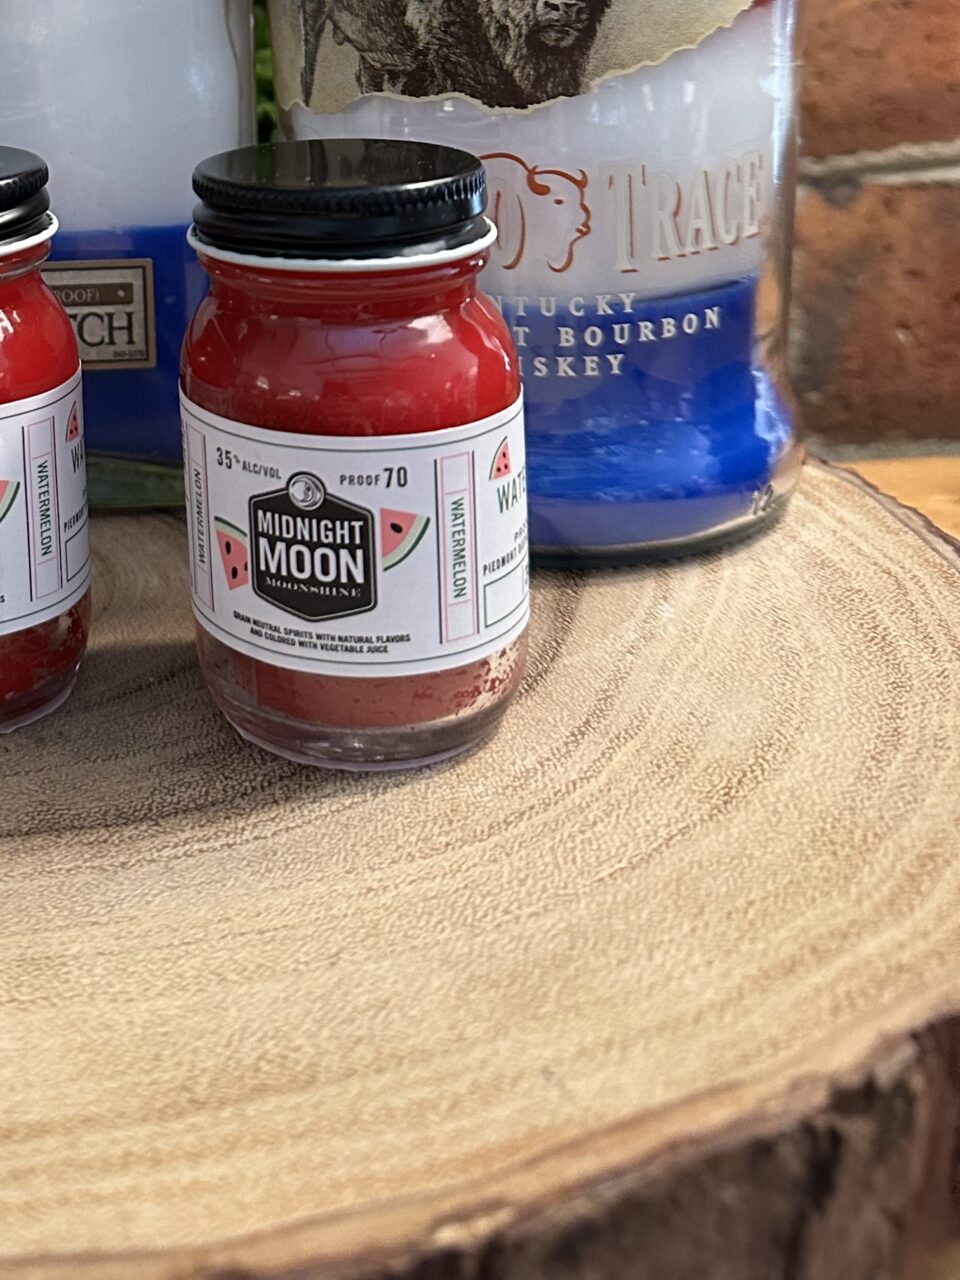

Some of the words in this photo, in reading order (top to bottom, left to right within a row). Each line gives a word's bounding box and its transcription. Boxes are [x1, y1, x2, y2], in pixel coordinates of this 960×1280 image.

[598, 151, 764, 273] TRACE
[558, 306, 721, 348] BOURBON
[242, 460, 282, 480] ALC/VOL
[340, 474, 381, 487] PROOF
[383, 467, 408, 488] 70
[37, 460, 53, 557] WATERMELON
[194, 469, 206, 564] WATERMELON
[257, 508, 364, 545] MIDNIGHT
[259, 536, 365, 584] MOON
[450, 496, 468, 599] WATERMELON
[265, 576, 361, 598] MOONSHINE
[233, 610, 251, 624] GRAIN
[252, 619, 281, 634] NEUTRAL
[283, 628, 313, 639] SPIRITS
[315, 633, 336, 641] WITH
[337, 634, 374, 644] NATURAL
[376, 633, 411, 644] FLAVORS
[250, 627, 263, 637] AND
[265, 634, 296, 646] COLORED
[298, 640, 318, 649] WITH
[320, 643, 364, 653] VEGETABLE
[366, 645, 389, 653] JUICE
